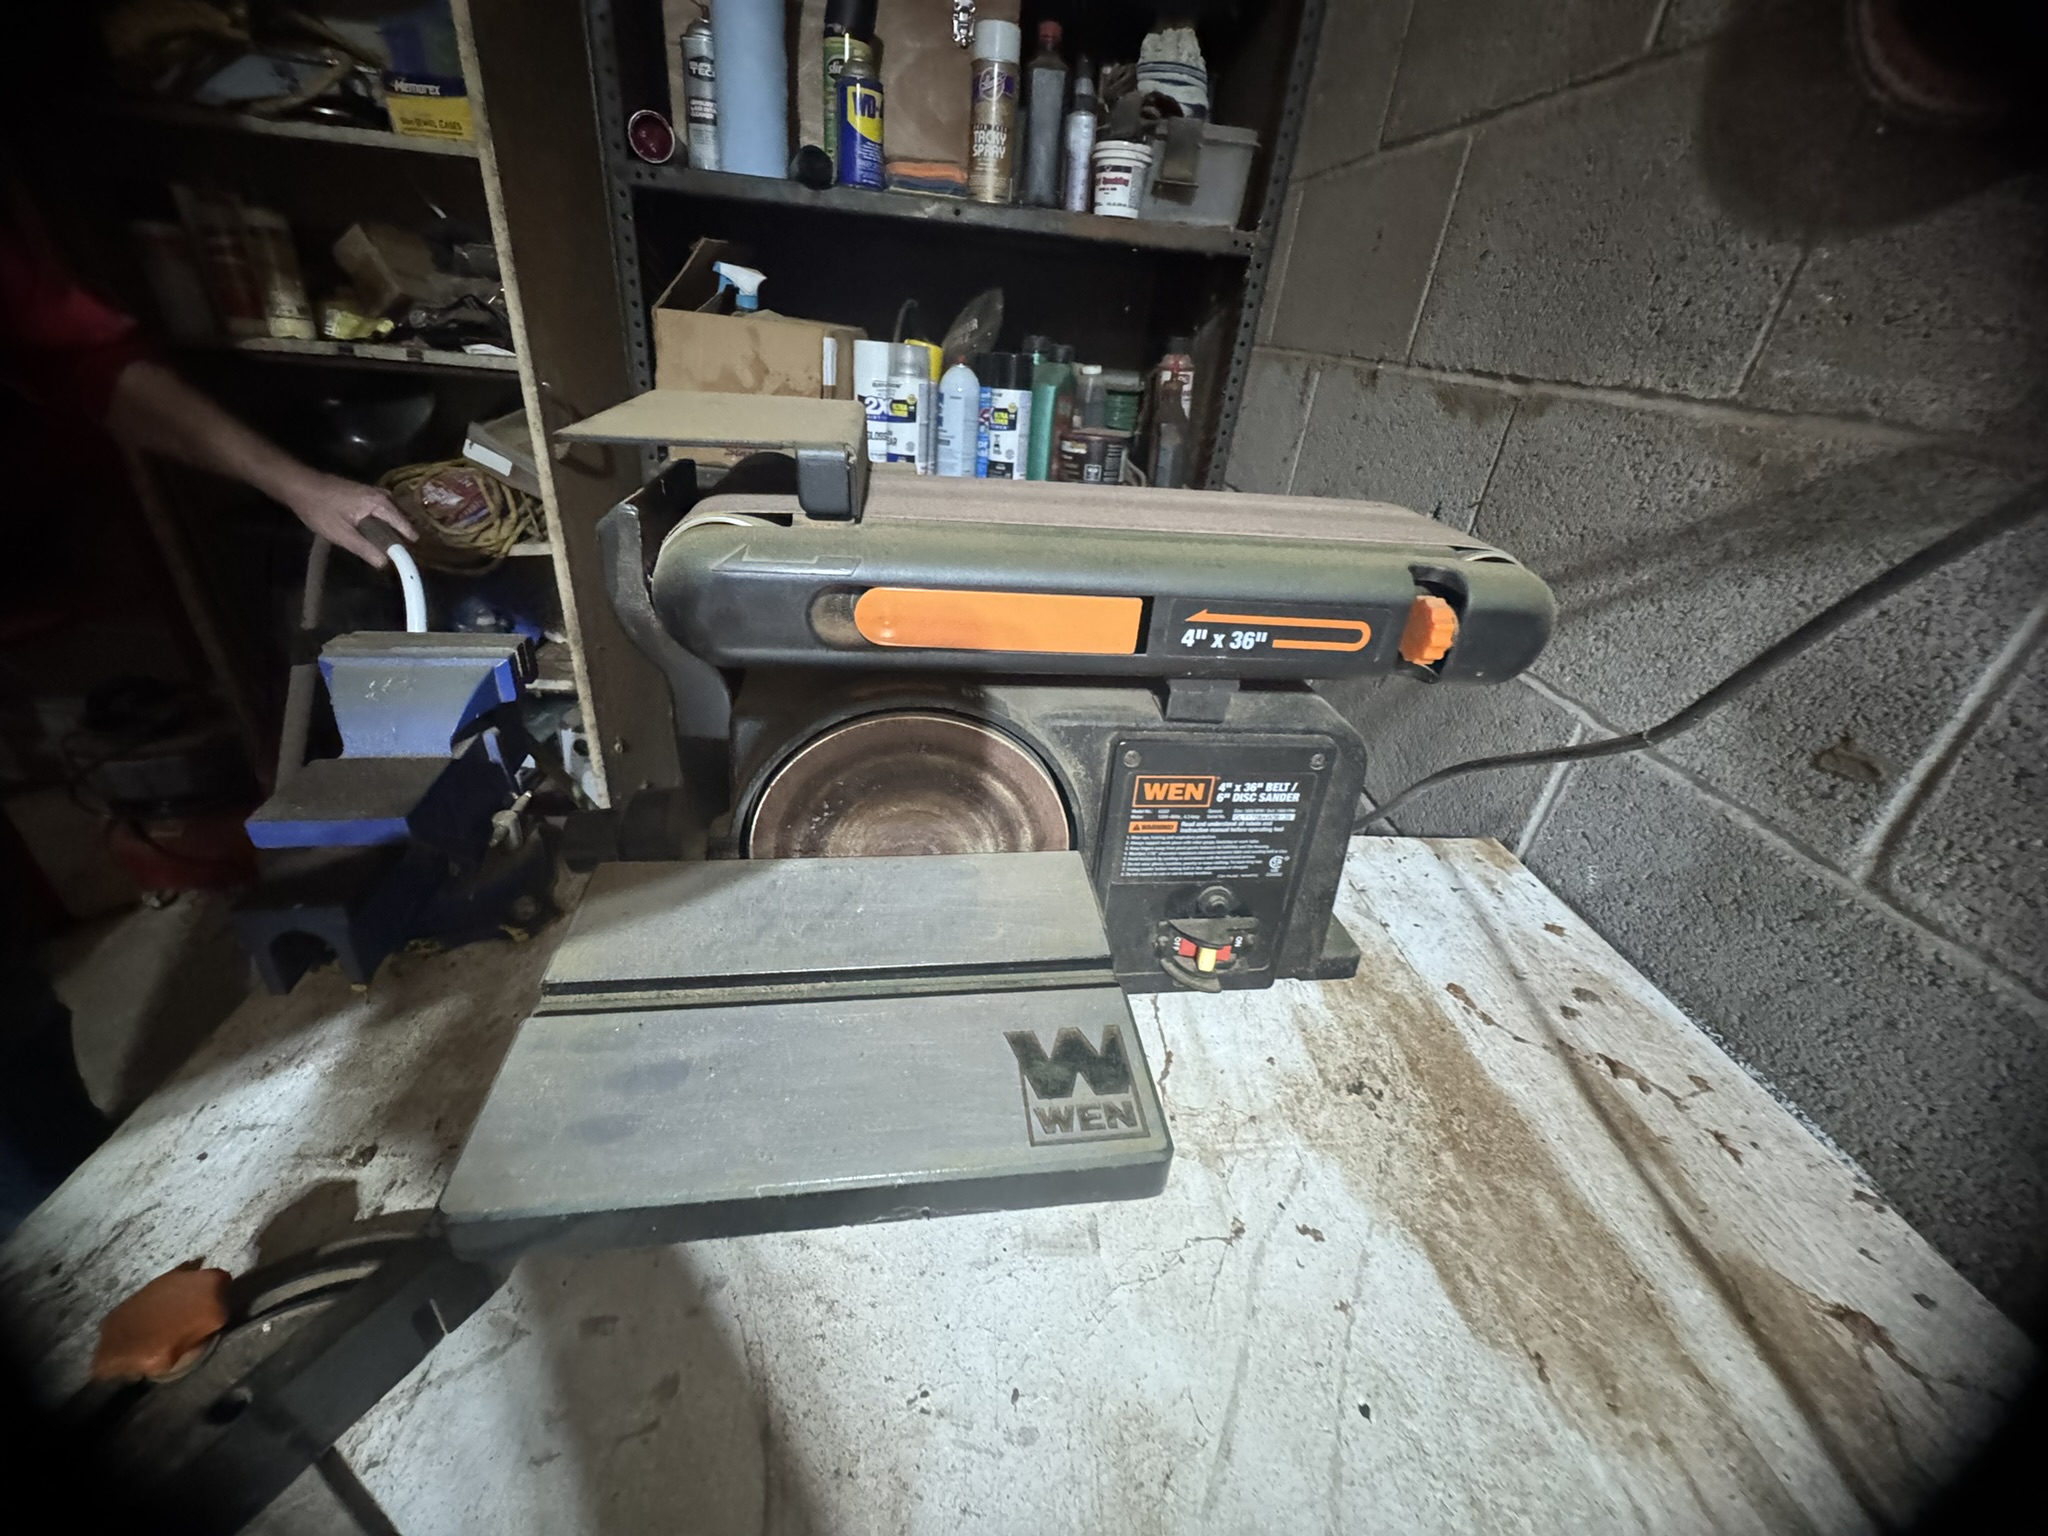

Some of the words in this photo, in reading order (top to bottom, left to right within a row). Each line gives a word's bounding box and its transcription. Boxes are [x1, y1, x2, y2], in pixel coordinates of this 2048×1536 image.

[394, 79, 441, 96] Memorex
[973, 130, 1007, 146] TACKY
[972, 143, 1006, 159] SPRAY
[865, 395, 893, 416] 2X
[1181, 629, 1208, 647] 4"
[1210, 634, 1226, 648] x
[1229, 630, 1268, 650] 36"
[1143, 783, 1205, 801] WEN
[1218, 782, 1233, 792] 4"
[1243, 782, 1263, 793] 36"
[1265, 782, 1290, 792] BELT
[1216, 793, 1231, 802] 6"
[1232, 793, 1257, 803] DISC
[1258, 793, 1301, 803] SANDER
[1033, 1100, 1138, 1134] WEN
